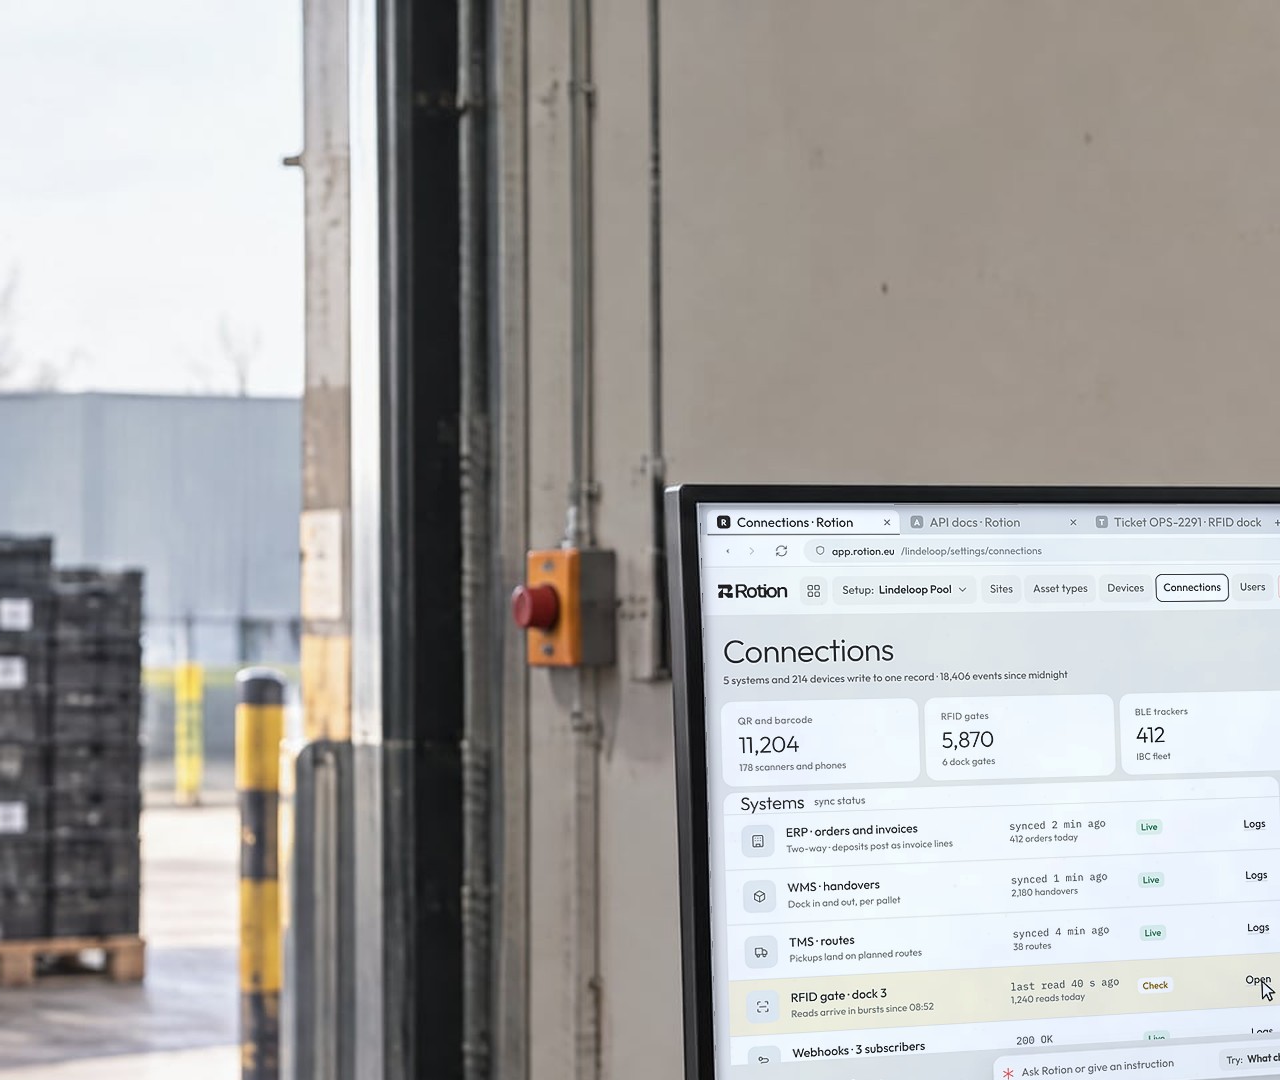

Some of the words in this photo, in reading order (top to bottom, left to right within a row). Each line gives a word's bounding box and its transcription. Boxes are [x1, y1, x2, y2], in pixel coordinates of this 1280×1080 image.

[737, 517, 809, 527] Connections
[817, 517, 853, 527] Rotion
[930, 517, 949, 527] API
[952, 517, 978, 527] docs
[985, 517, 1020, 527] Rotion
[1114, 517, 1147, 527] Ticket
[1149, 517, 1201, 527] OPS-2291
[1209, 517, 1234, 527] RFID
[1236, 517, 1261, 527] dock
[832, 547, 894, 558] app.rotion.eu
[901, 547, 1042, 557] /lindeloop/settings/connections
[735, 584, 788, 598] Rotion
[843, 585, 874, 596] Setup:
[879, 585, 928, 596] Lindeloop
[930, 585, 951, 594] Pool
[990, 584, 1013, 593] Sites
[1033, 584, 1059, 593] Asset
[1062, 584, 1088, 595] types
[1108, 583, 1144, 592] Devices
[1163, 583, 1221, 592] Connections
[1240, 582, 1266, 591] Users
[724, 639, 893, 664] Connections
[723, 676, 729, 685] 5
[731, 676, 769, 687] systems
[771, 675, 790, 684] and
[792, 675, 808, 684] 214
[810, 675, 845, 683] devices
[847, 674, 871, 682] write
[873, 674, 883, 682] to
[904, 672, 934, 682] record
[940, 672, 970, 681] 18,406
[972, 672, 1002, 680] events
[1004, 671, 1027, 680] since
[1029, 670, 1068, 681] midnight
[941, 712, 962, 720] RFID
[964, 712, 989, 722] gates
[1135, 708, 1151, 716] BLE
[1154, 708, 1188, 716] trackers
[738, 717, 752, 725] QR
[755, 717, 772, 725] and
[775, 716, 813, 724] barcode
[942, 731, 994, 750] 5,870
[1136, 727, 1165, 743] 412
[739, 736, 799, 756] 11,204
[741, 797, 804, 814] Systems
[814, 799, 835, 808] sync
[837, 796, 865, 805] status
[1010, 821, 1045, 832] synced
[1052, 820, 1058, 829] 2
[1064, 819, 1082, 829] min
[1088, 820, 1106, 830] ago
[1141, 823, 1158, 831] Live
[1244, 820, 1266, 830] Logs
[786, 827, 808, 838] ERP
[815, 826, 850, 837] orders
[852, 825, 873, 835] and
[876, 824, 918, 834] invoices
[1143, 876, 1159, 884] Live
[1246, 871, 1267, 881] Logs
[787, 882, 817, 892] WMS
[824, 880, 880, 891] handovers
[1145, 929, 1161, 937] Live
[1248, 923, 1269, 934] Logs
[789, 936, 814, 947] TMS
[821, 936, 855, 946] routes
[1011, 982, 1035, 991] last
[1042, 980, 1065, 990] read
[1071, 979, 1083, 988] 40
[1101, 978, 1119, 989] ago
[1143, 981, 1168, 990] Check
[1246, 975, 1271, 987] Open
[791, 992, 817, 1003] RFID
[820, 991, 845, 1004] gate
[852, 989, 878, 1000] dock
[881, 988, 887, 998] 3
[1017, 1036, 1035, 1045] 200
[1041, 1035, 1053, 1044] OK
[792, 1046, 849, 1058] Webhooks
[856, 1044, 862, 1055] 3
[865, 1042, 925, 1054] subscribers
[1227, 1056, 1243, 1066] Try:
[1247, 1054, 1272, 1063] What
[1022, 1067, 1039, 1077] Ask
[1042, 1065, 1073, 1075] Rotion
[1075, 1066, 1086, 1074] or
[1088, 1063, 1108, 1075] give
[1124, 1059, 1174, 1070] instruction
